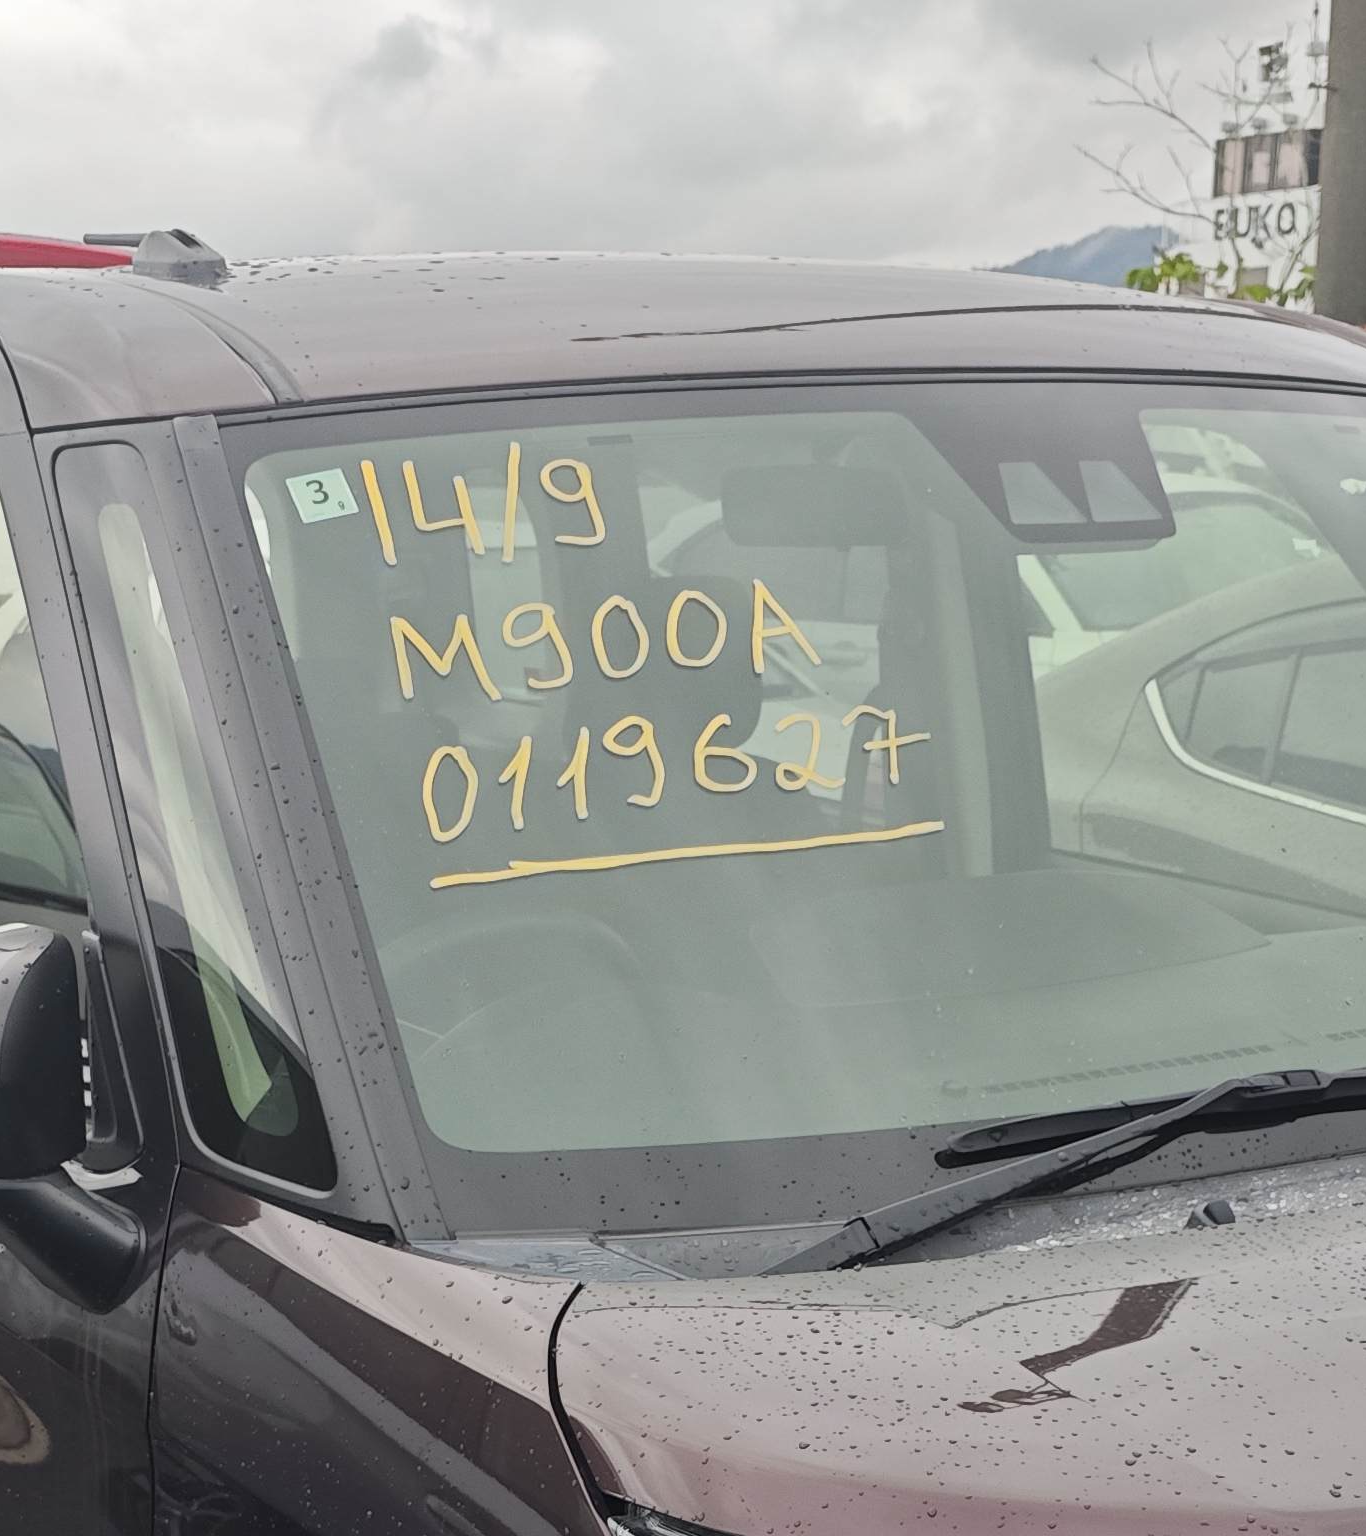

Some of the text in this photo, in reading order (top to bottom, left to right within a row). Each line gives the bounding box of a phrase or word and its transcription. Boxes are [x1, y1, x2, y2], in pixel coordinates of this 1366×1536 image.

[305, 479, 330, 505] 3
[360, 441, 607, 567] 14/9
[390, 578, 822, 701] M900A
[421, 704, 932, 843] 0119627
